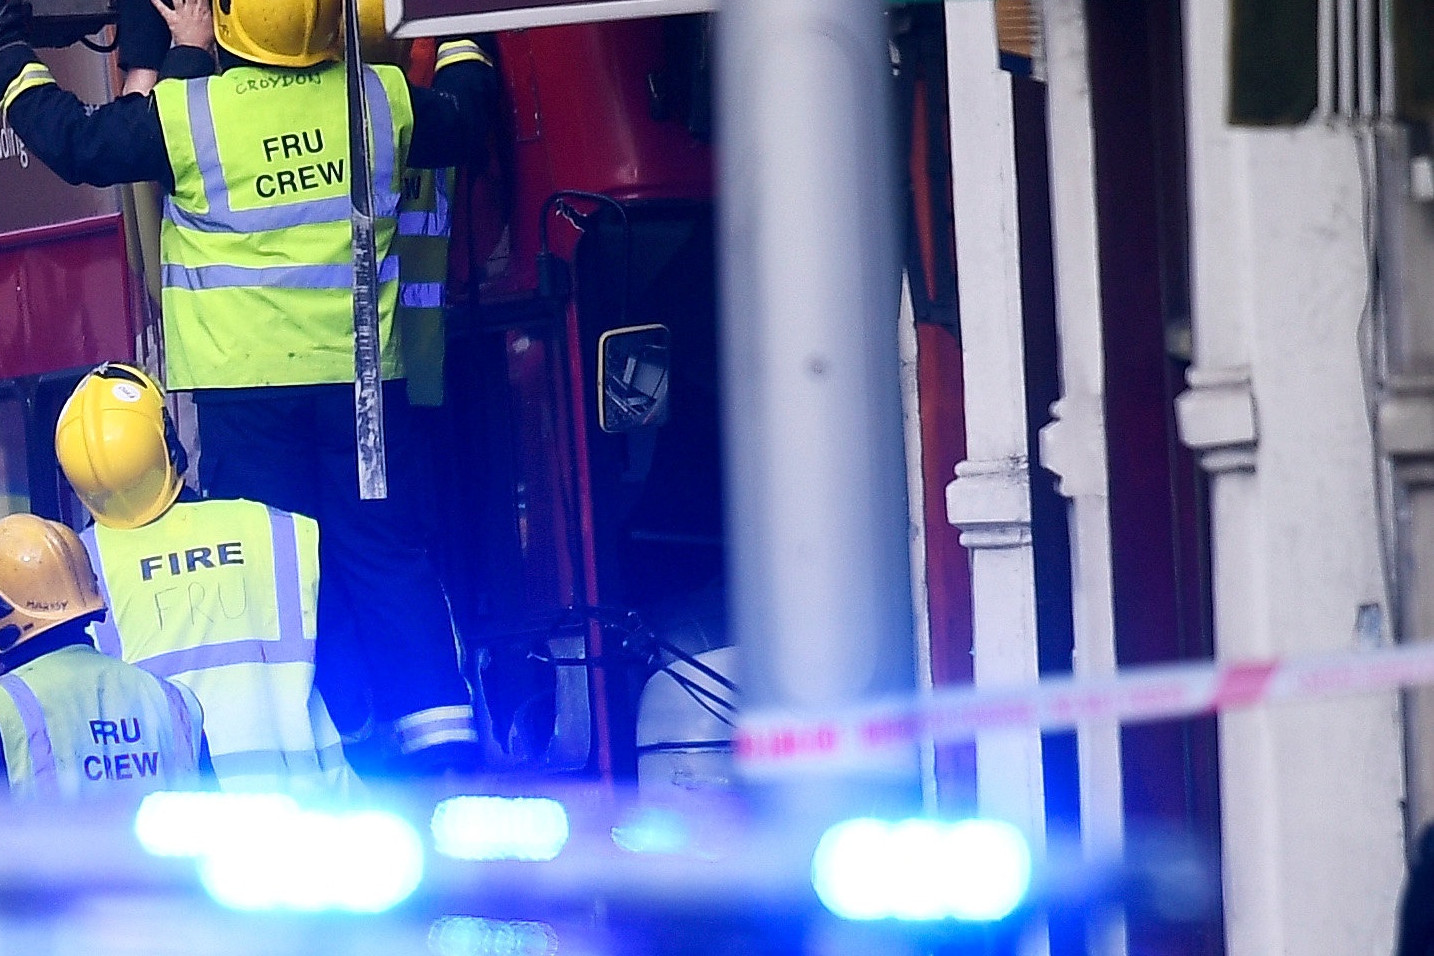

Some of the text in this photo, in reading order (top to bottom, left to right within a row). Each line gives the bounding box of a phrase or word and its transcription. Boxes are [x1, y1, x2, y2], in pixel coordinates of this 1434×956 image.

[235, 72, 322, 95] CROYDON
[262, 128, 324, 163] FRU
[256, 159, 344, 198] CREW
[140, 542, 244, 581] FIRE
[154, 576, 247, 631] FRU
[89, 717, 141, 745] FRU
